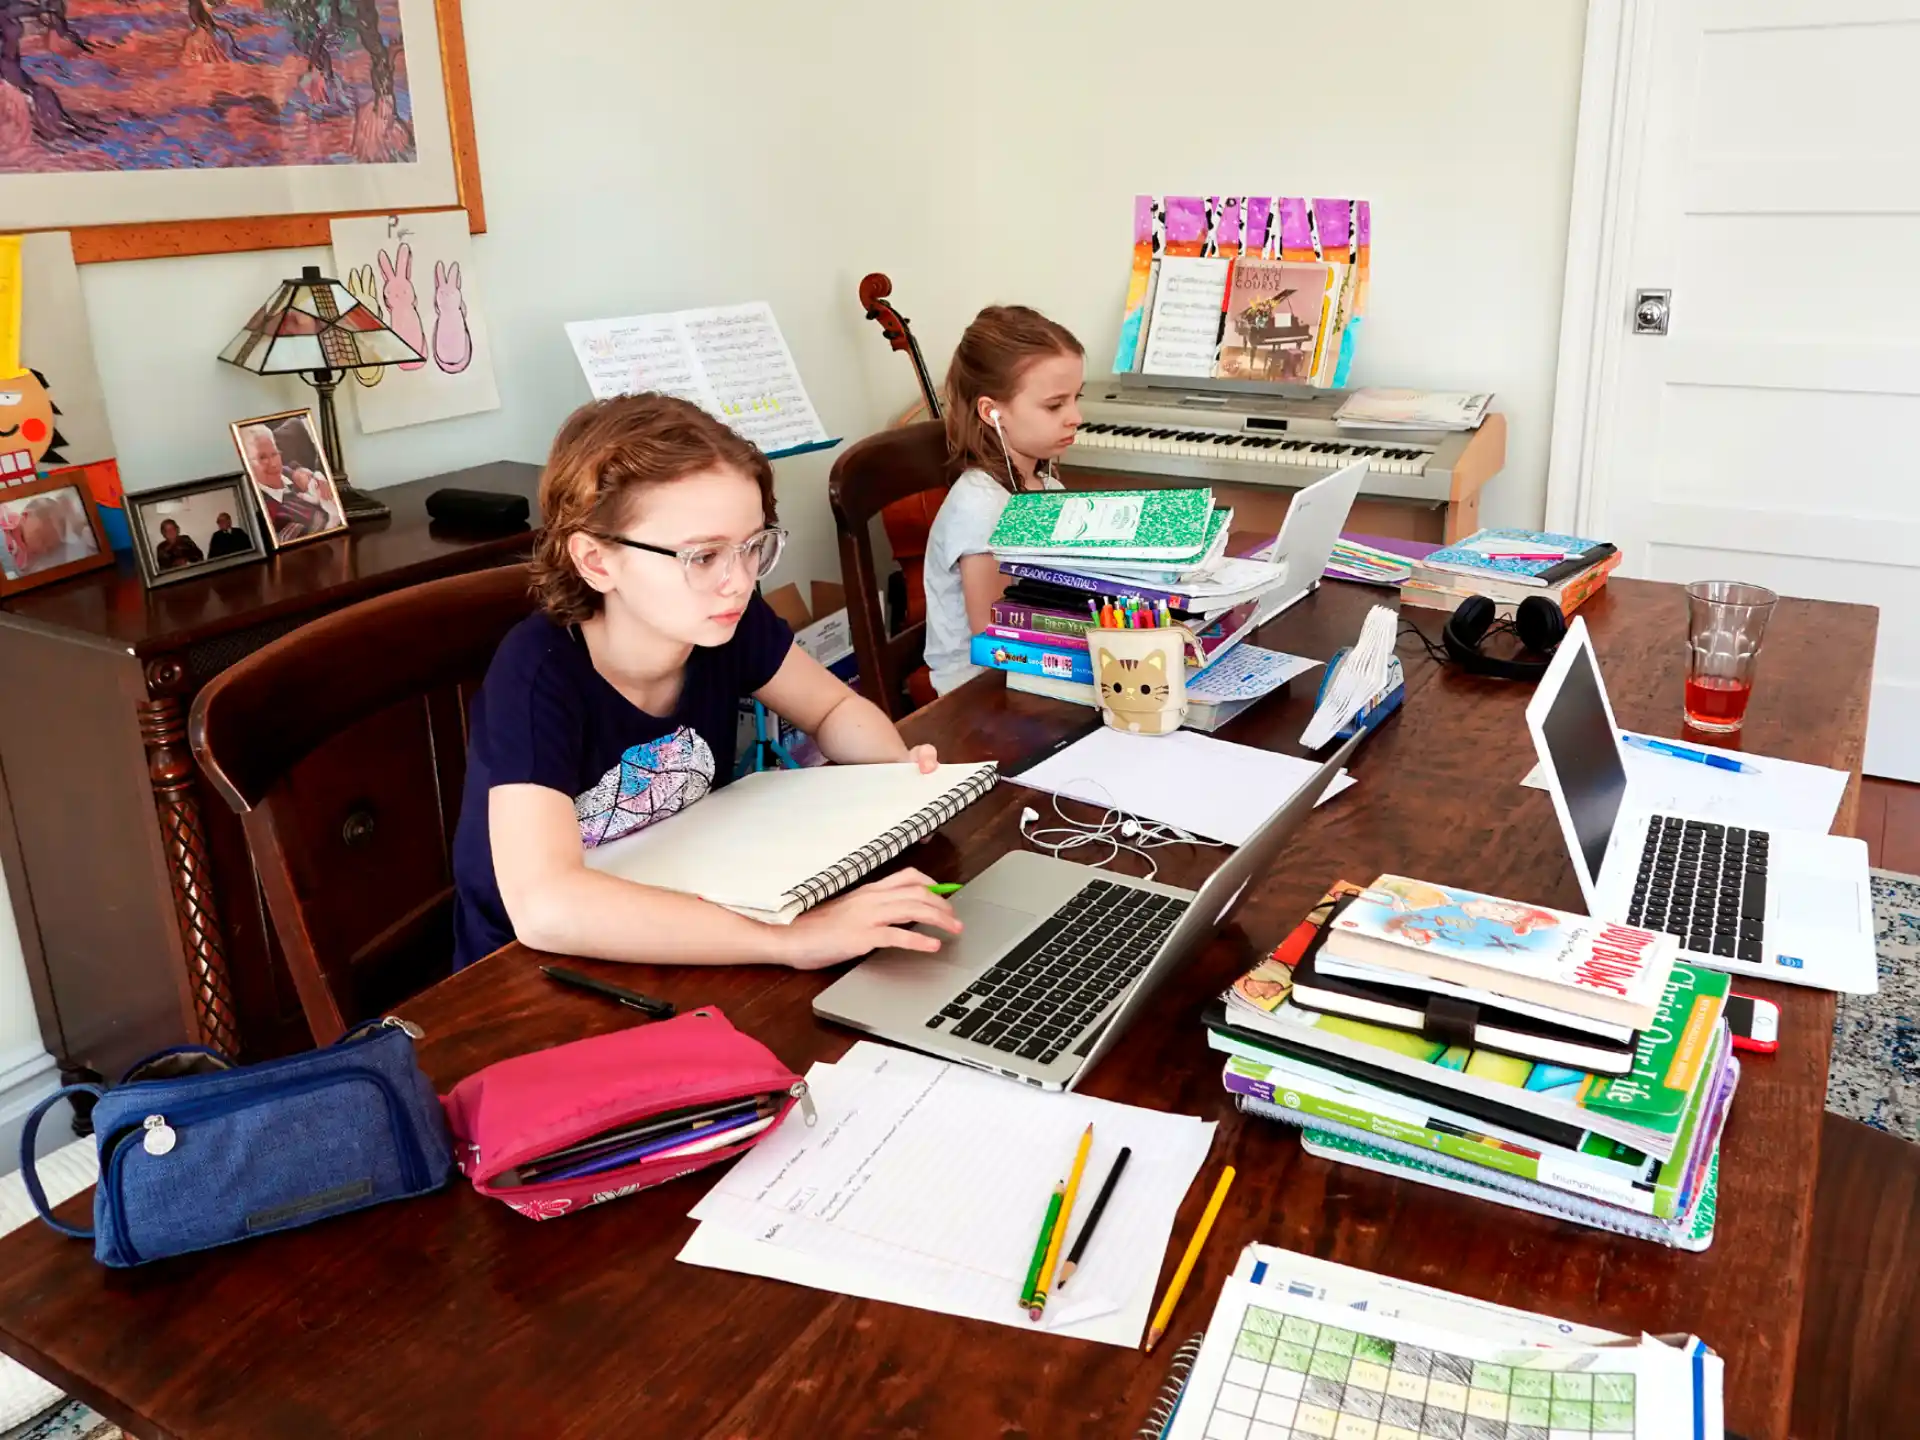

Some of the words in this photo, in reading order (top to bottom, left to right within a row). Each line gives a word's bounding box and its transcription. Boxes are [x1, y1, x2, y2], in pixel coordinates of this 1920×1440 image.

[1235, 268, 1283, 281] PIANO
[1235, 279, 1281, 291] COURSE
[1019, 566, 1052, 582] READING
[1052, 571, 1099, 590] ESSENTIALS
[1593, 921, 1656, 954] JUDY
[1574, 946, 1643, 996] BLUME
[1653, 967, 1696, 1022] Christ
[1635, 1025, 1673, 1066] Our
[1606, 1068, 1657, 1102] Life
